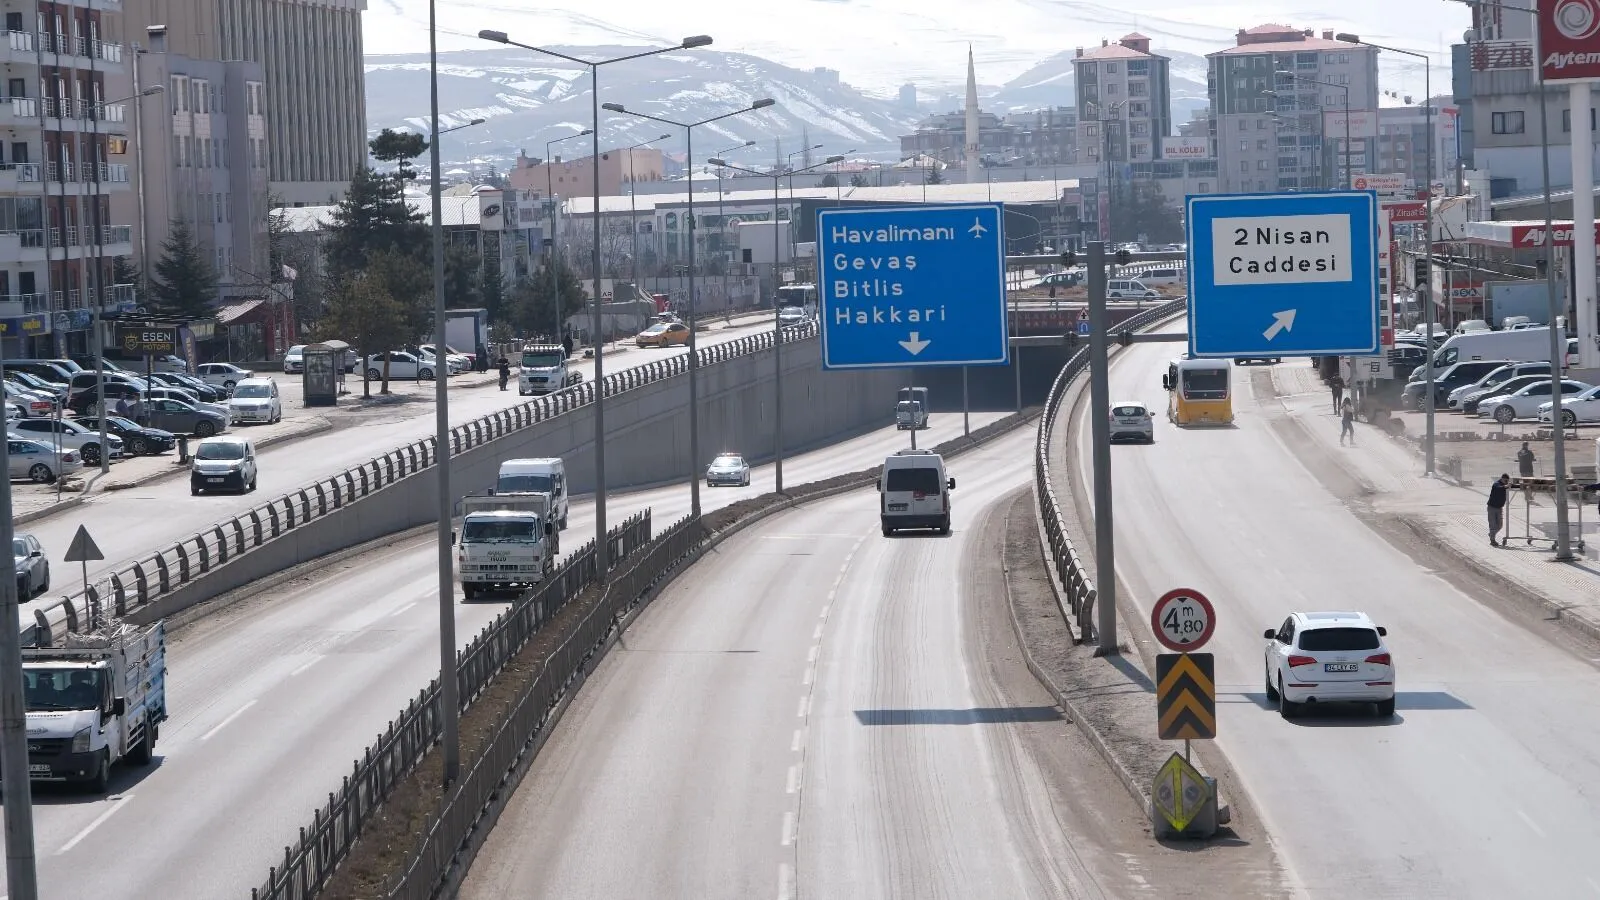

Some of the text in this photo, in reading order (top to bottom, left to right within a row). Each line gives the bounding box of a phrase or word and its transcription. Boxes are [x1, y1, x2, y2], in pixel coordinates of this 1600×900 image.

[832, 225, 954, 244] Havalimanı
[1234, 227, 1330, 246] 2 Nisan
[834, 253, 917, 271] Gevaş
[1229, 255, 1336, 274] Caddesi
[834, 279, 903, 298] Bitlis
[835, 305, 946, 325] Hakkari
[142, 332, 171, 341] ESEN
